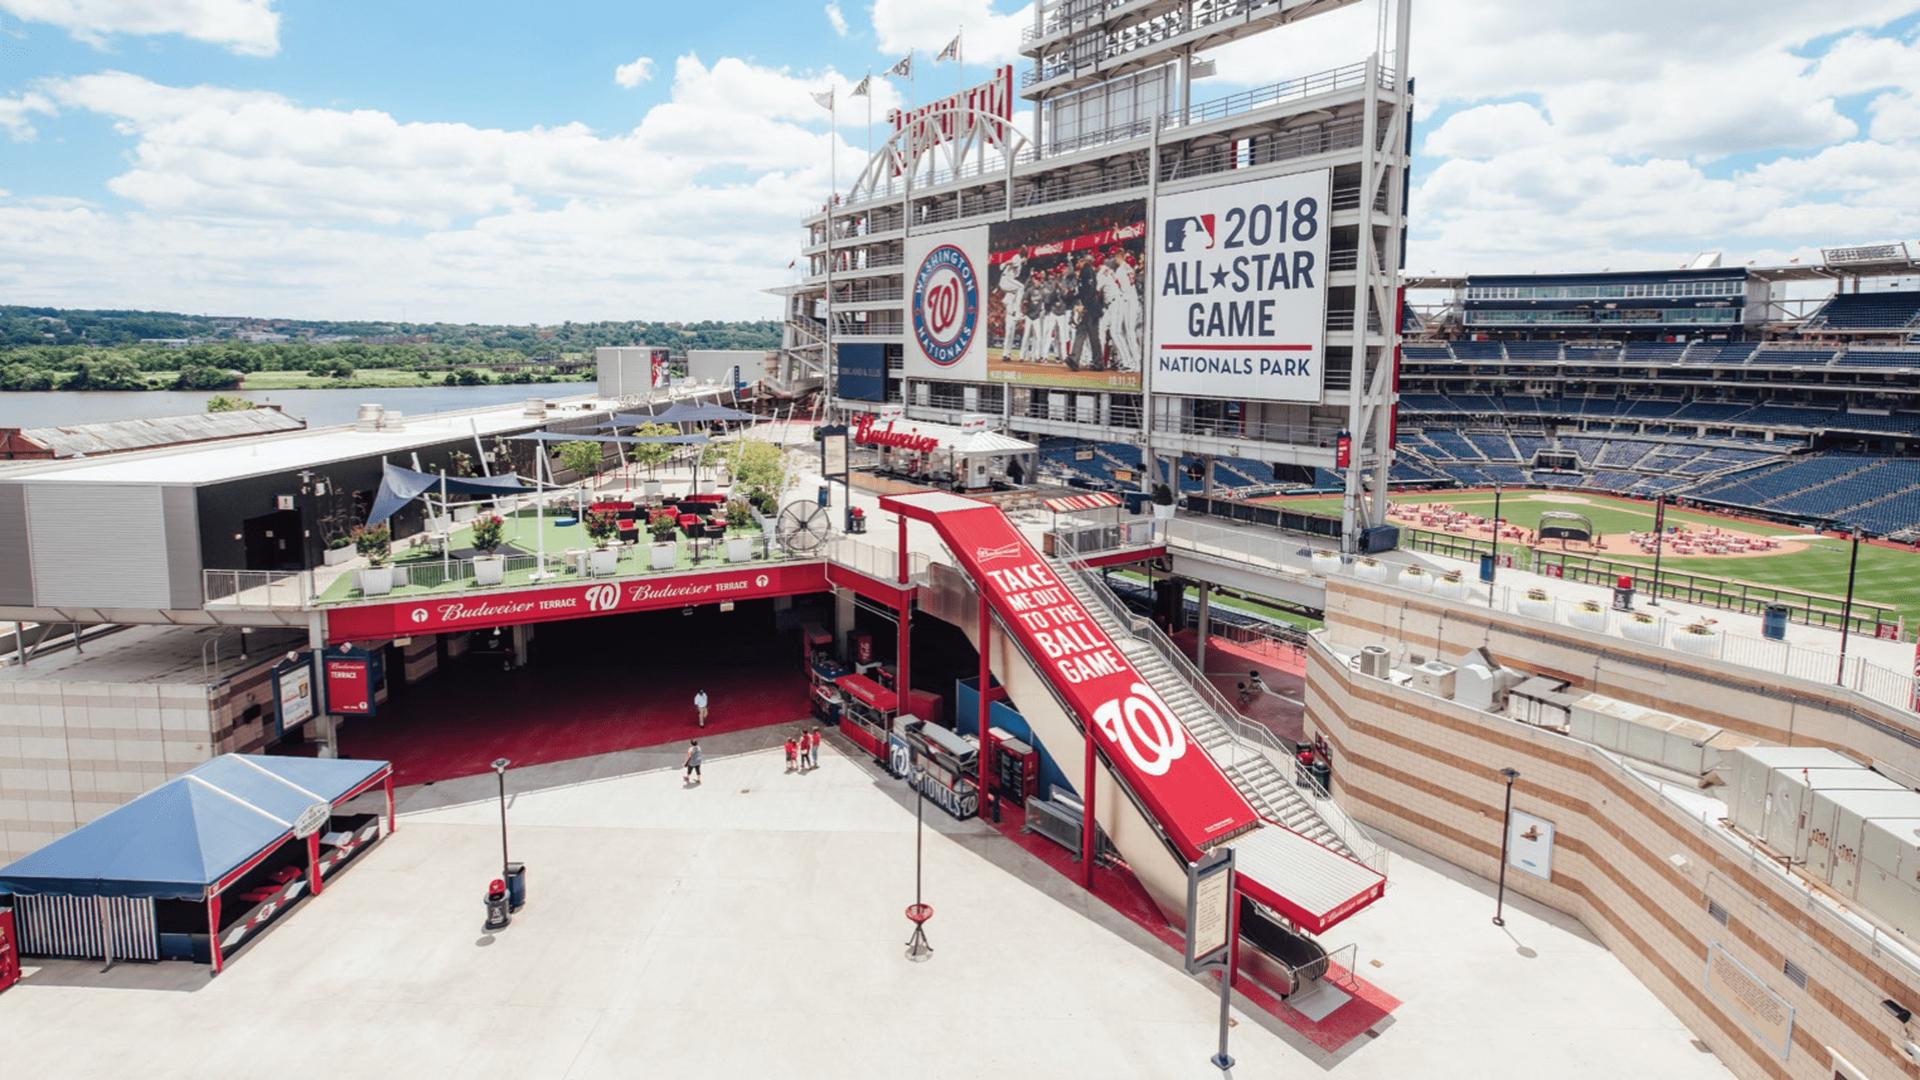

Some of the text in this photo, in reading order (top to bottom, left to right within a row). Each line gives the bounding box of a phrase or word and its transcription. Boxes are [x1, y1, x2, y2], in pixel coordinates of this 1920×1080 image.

[1224, 197, 1318, 249] 2018
[915, 250, 974, 293] WASHINGTON
[1188, 299, 1276, 337] GAME
[917, 326, 971, 360] NATIONALS
[1159, 356, 1311, 377] NATIONALS PARK
[851, 413, 940, 453] Budweiser
[987, 564, 1054, 593] TAKE
[437, 600, 534, 622] Budweiser
[539, 598, 577, 610] TERRACE
[628, 583, 712, 602] Budweiser
[715, 580, 749, 592] TERRACE
[1005, 587, 1067, 612] ME OUT
[1019, 603, 1085, 631] TO THE
[1033, 623, 1106, 659] BALL
[331, 671, 357, 679] TERRACE
[1057, 649, 1127, 684] GAME
